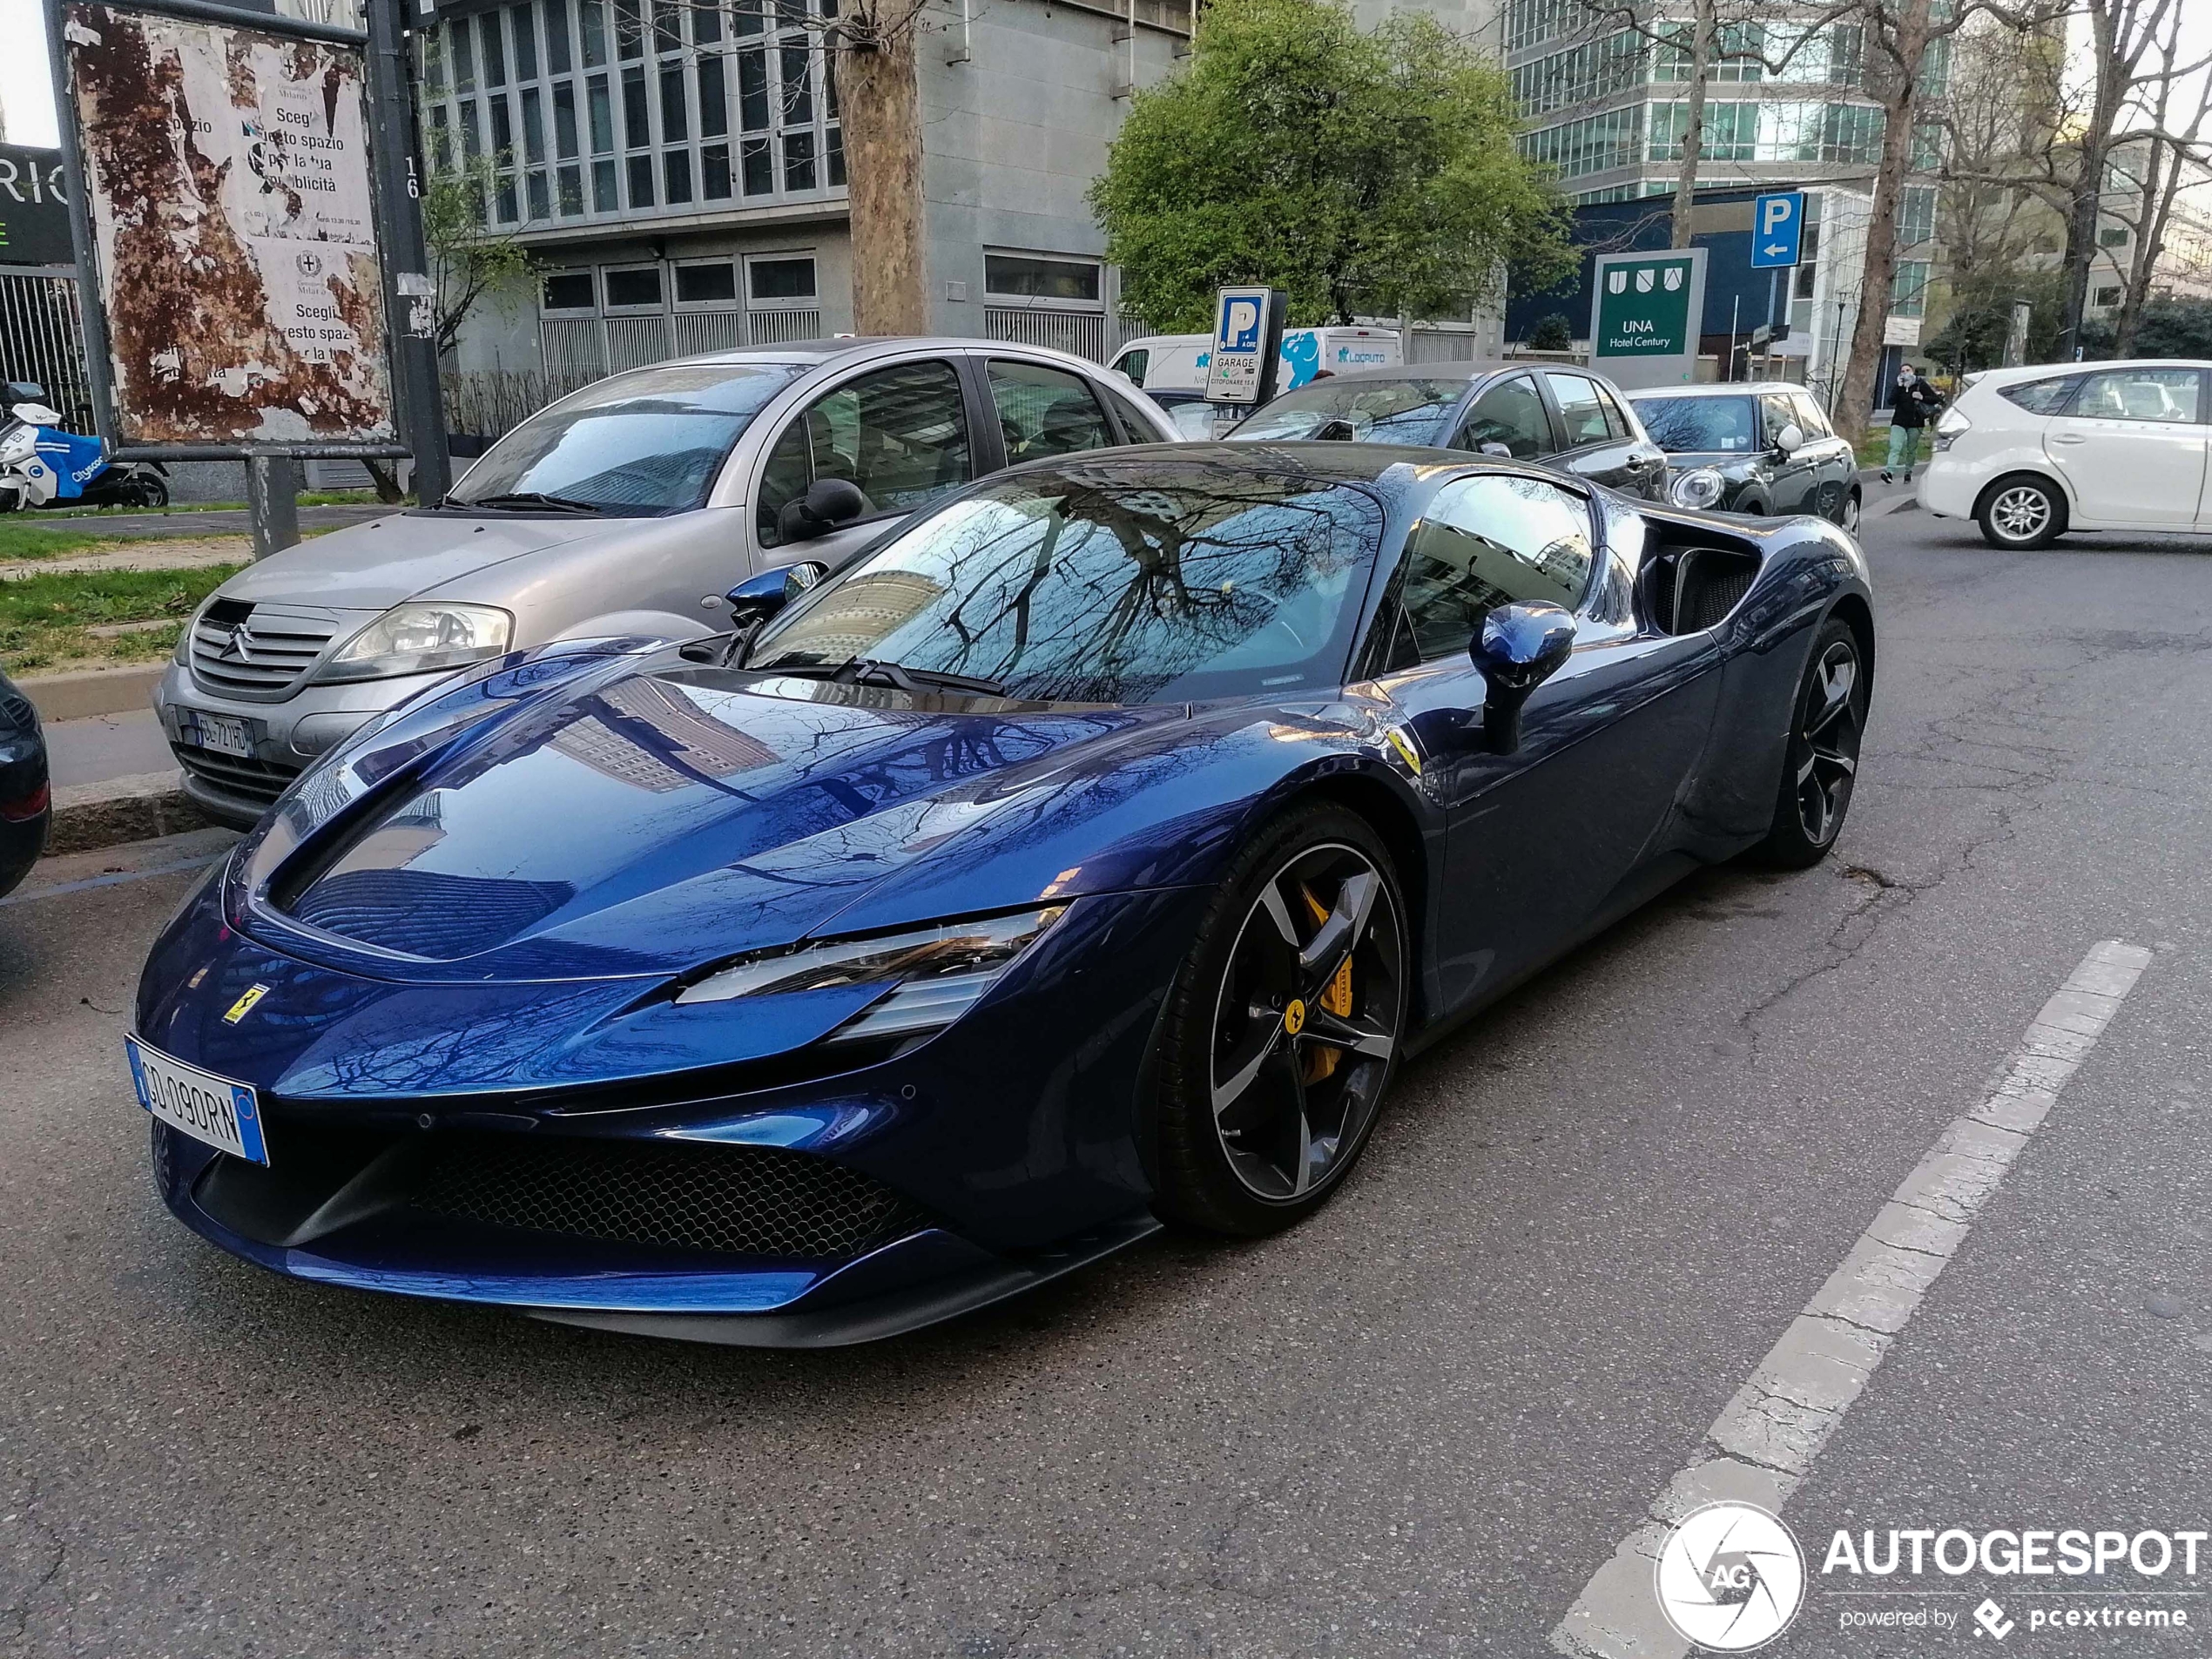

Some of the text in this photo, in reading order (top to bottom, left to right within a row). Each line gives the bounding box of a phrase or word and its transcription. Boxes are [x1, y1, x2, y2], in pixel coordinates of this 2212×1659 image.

[301, 135, 344, 151] spazio
[294, 153, 307, 166] la
[1764, 199, 1791, 235] P
[296, 304, 336, 321] Scegli
[1227, 301, 1257, 347] P
[1622, 319, 1654, 334] UNA
[1609, 336, 1670, 348] Hotel Century
[1217, 357, 1254, 368] GARAGE
